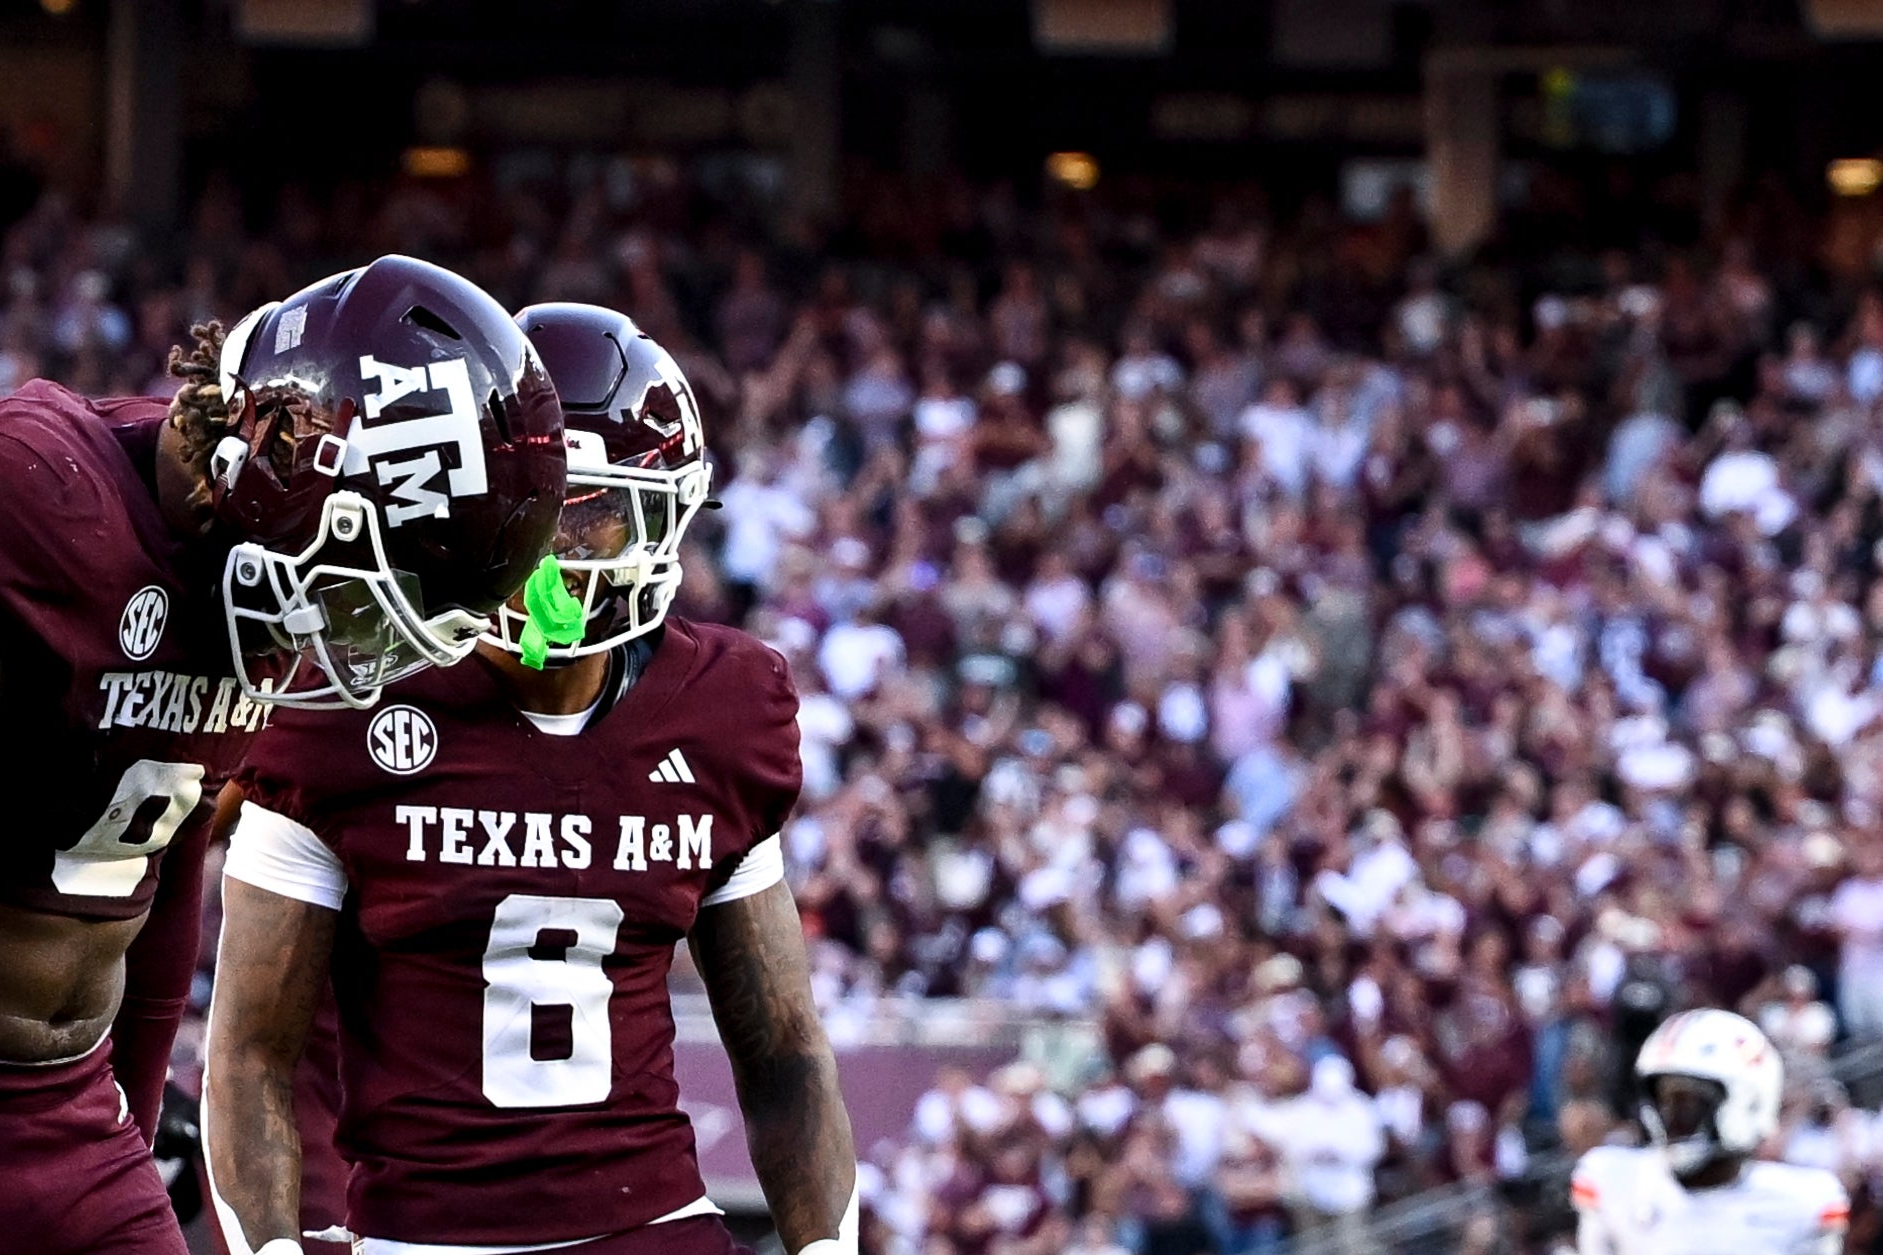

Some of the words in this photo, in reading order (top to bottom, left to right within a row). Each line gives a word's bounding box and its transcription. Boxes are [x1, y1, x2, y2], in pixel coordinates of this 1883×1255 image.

[123, 591, 164, 655] SEC
[98, 670, 208, 734] TEXAS
[373, 710, 431, 769] SEC
[395, 804, 593, 870] TEXAS
[613, 814, 715, 872] A&M
[482, 893, 625, 1109] 8
